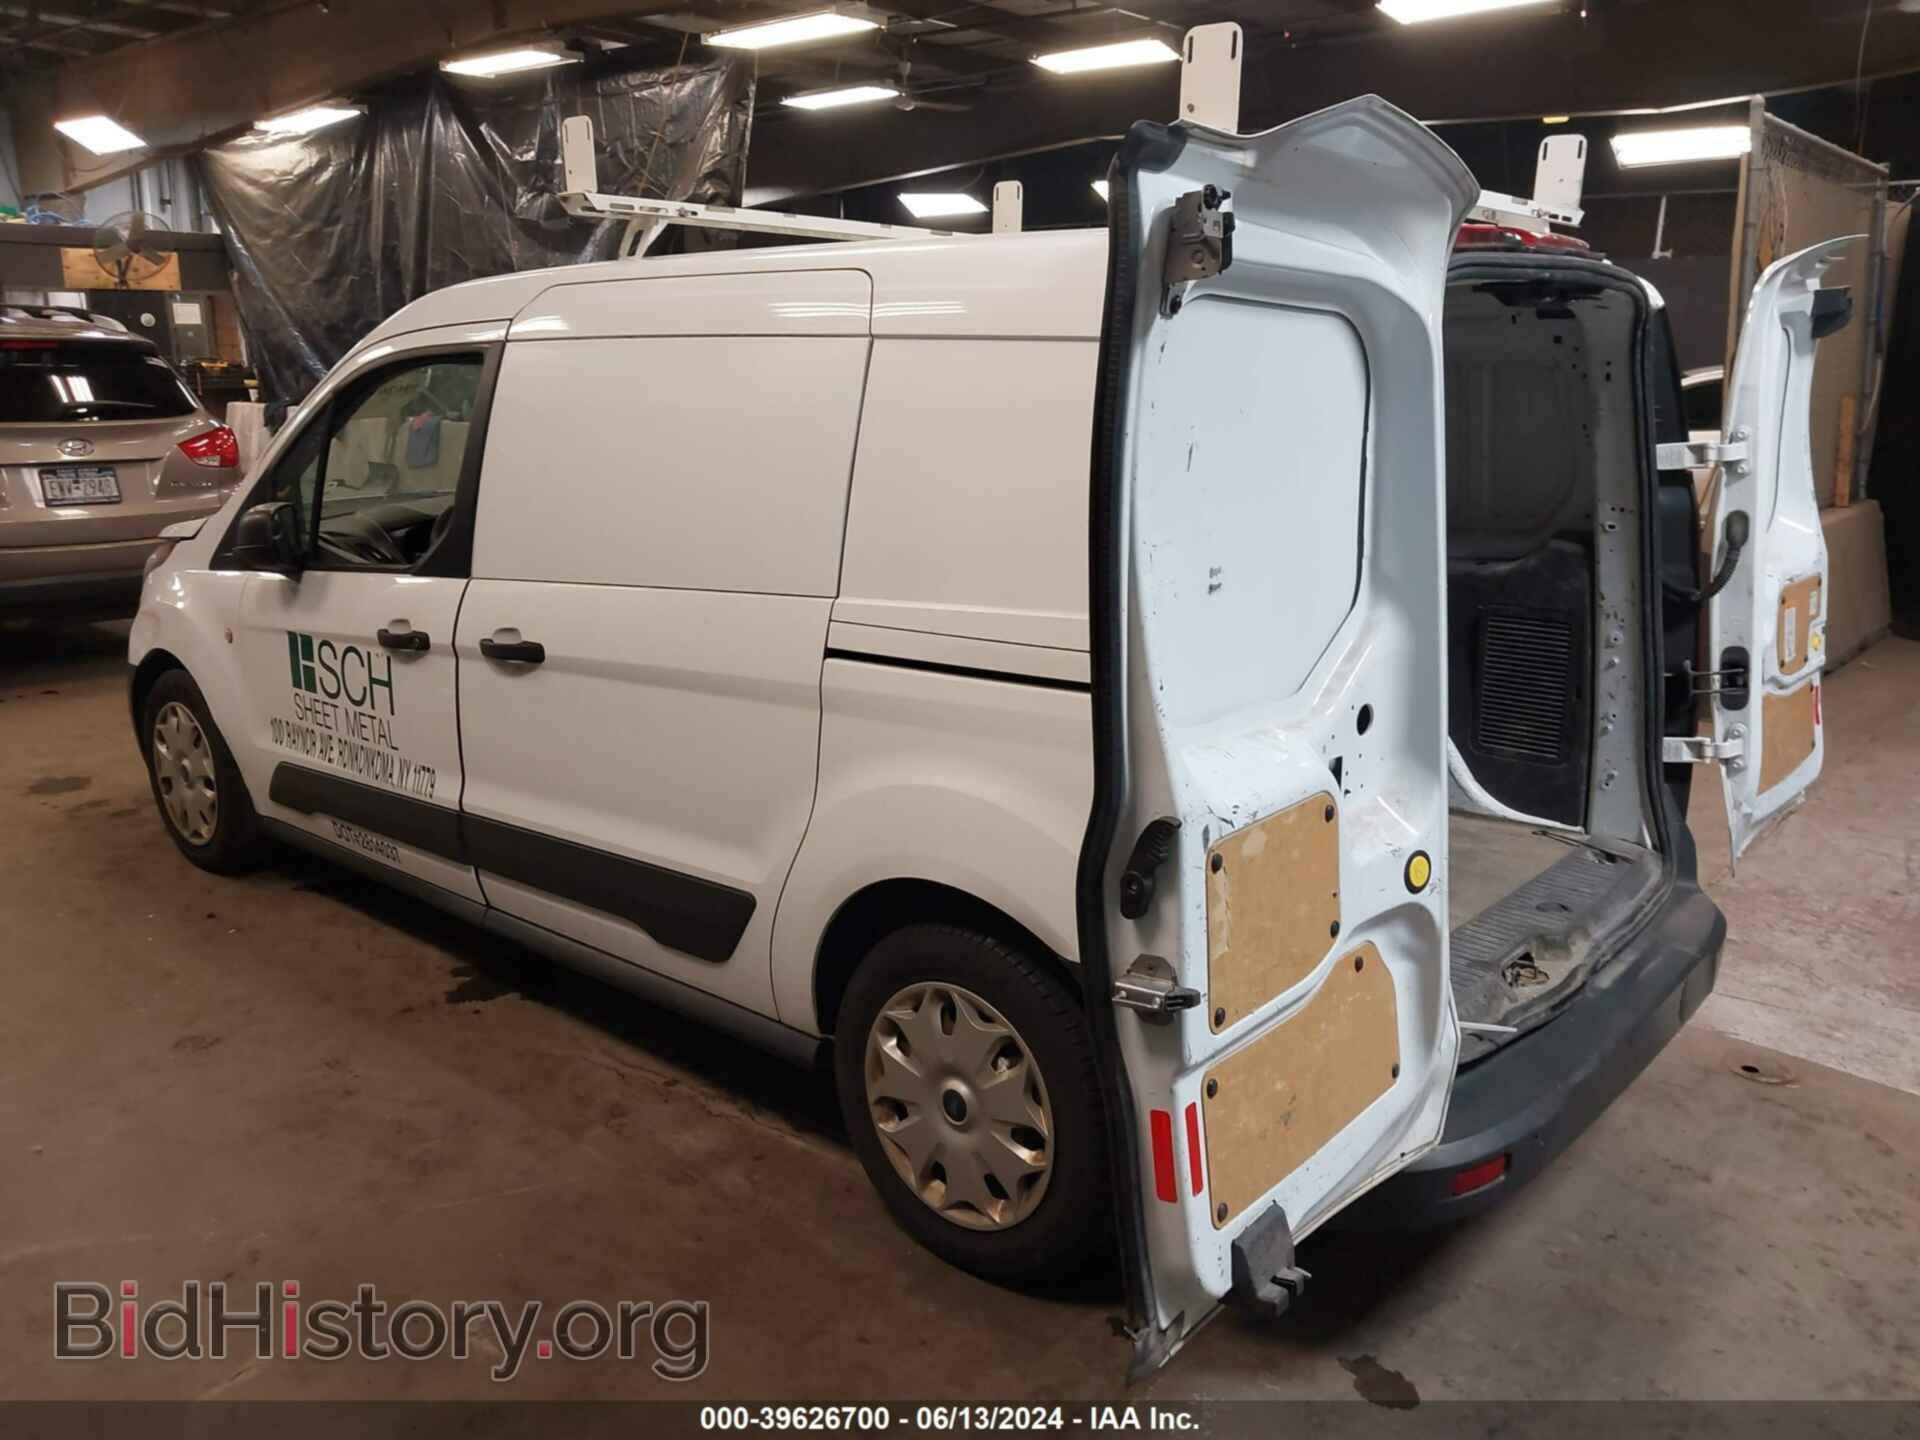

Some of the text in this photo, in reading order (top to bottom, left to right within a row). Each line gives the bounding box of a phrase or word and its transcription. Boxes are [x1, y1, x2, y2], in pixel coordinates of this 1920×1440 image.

[270, 717, 285, 746] 100
[286, 721, 317, 756] RAYNOR
[399, 757, 412, 791] NY
[294, 692, 399, 751] SHEET METAL
